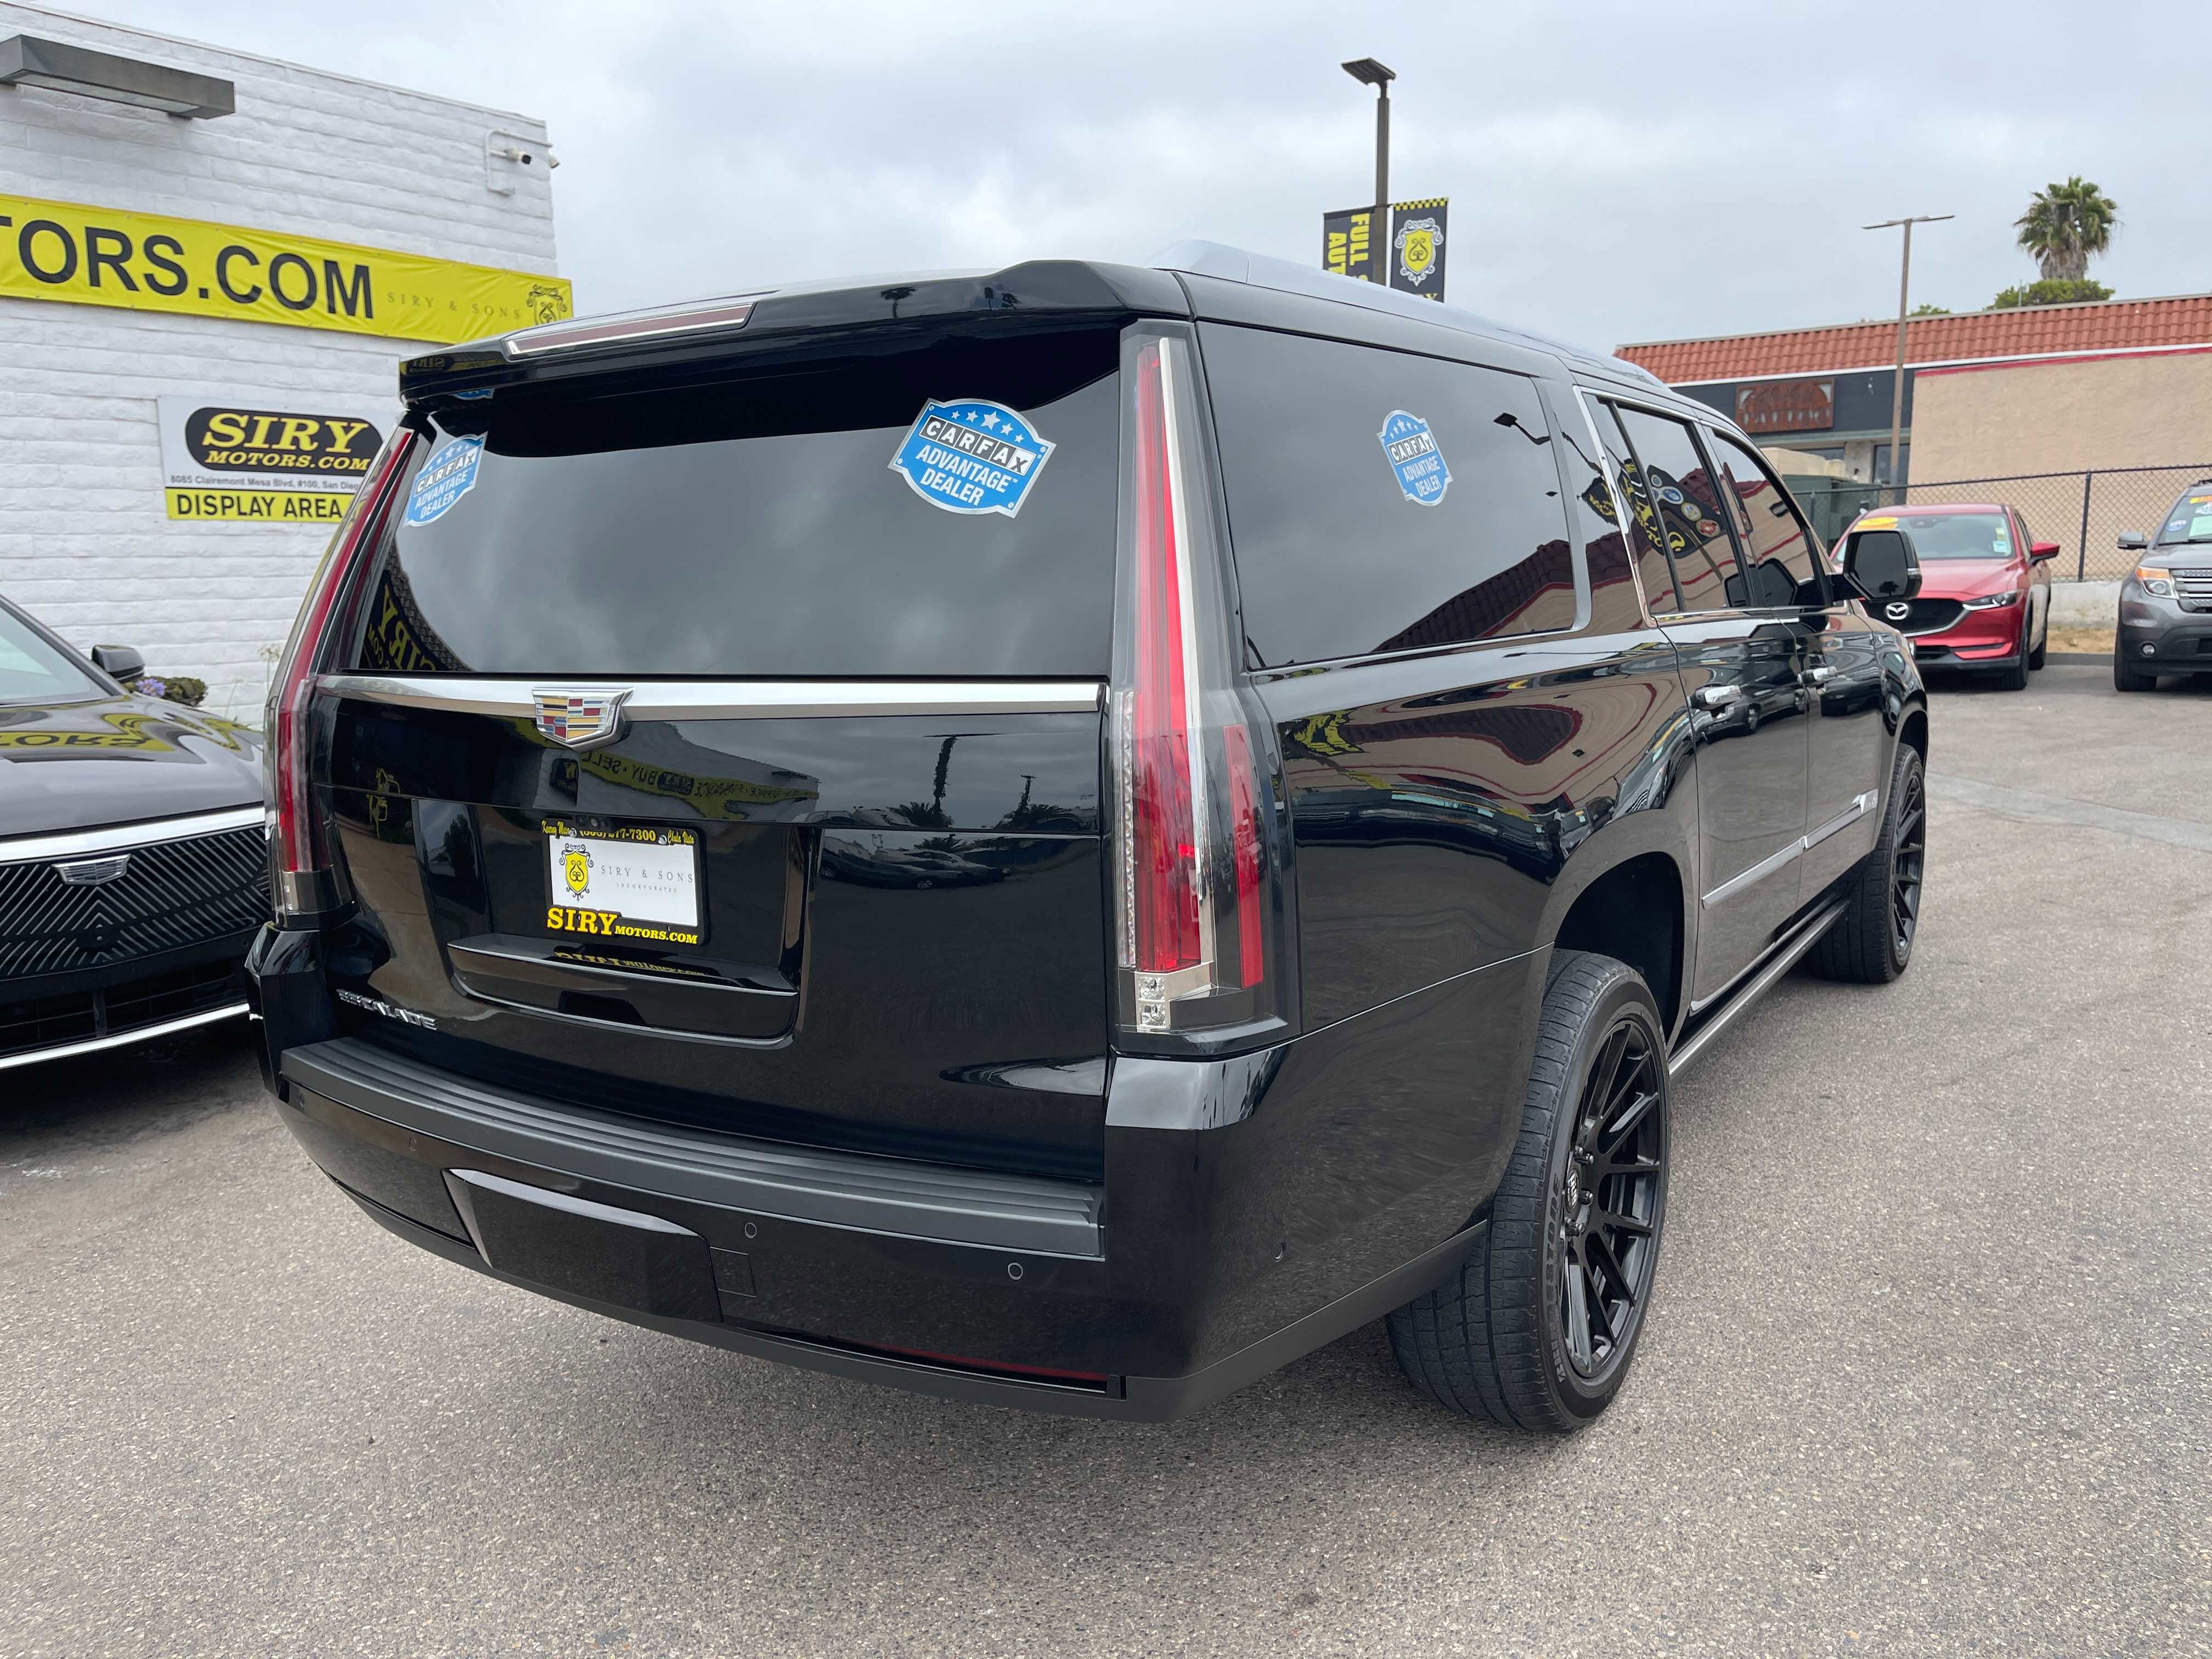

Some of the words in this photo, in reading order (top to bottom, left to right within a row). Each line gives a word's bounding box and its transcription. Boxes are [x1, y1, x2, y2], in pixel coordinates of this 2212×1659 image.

[1349, 213, 1370, 266] FULL
[0, 216, 373, 319] ORS.COM
[387, 291, 433, 308] SIRY
[448, 300, 458, 312] &
[472, 303, 520, 319] SONS
[202, 413, 369, 454] SIRY
[926, 421, 1029, 473] CARFAX
[1390, 433, 1435, 461] CARFAX
[205, 450, 371, 471] MOTORS.COM
[416, 453, 475, 493] CARFAX
[195, 476, 245, 486] Clairemont
[247, 478, 271, 487] Mesa
[919, 467, 985, 506] DEALER
[1415, 475, 1442, 498] DEALER
[177, 494, 275, 516] DISPLAY
[284, 497, 342, 518] AREA
[420, 489, 456, 520] DEALER
[601, 865, 631, 877] SIRY
[641, 868, 648, 878] &
[658, 871, 693, 883] SONS
[617, 882, 678, 893] INCORPORATED
[547, 907, 618, 935] SIRY
[614, 925, 698, 944] MOTORS.COM
